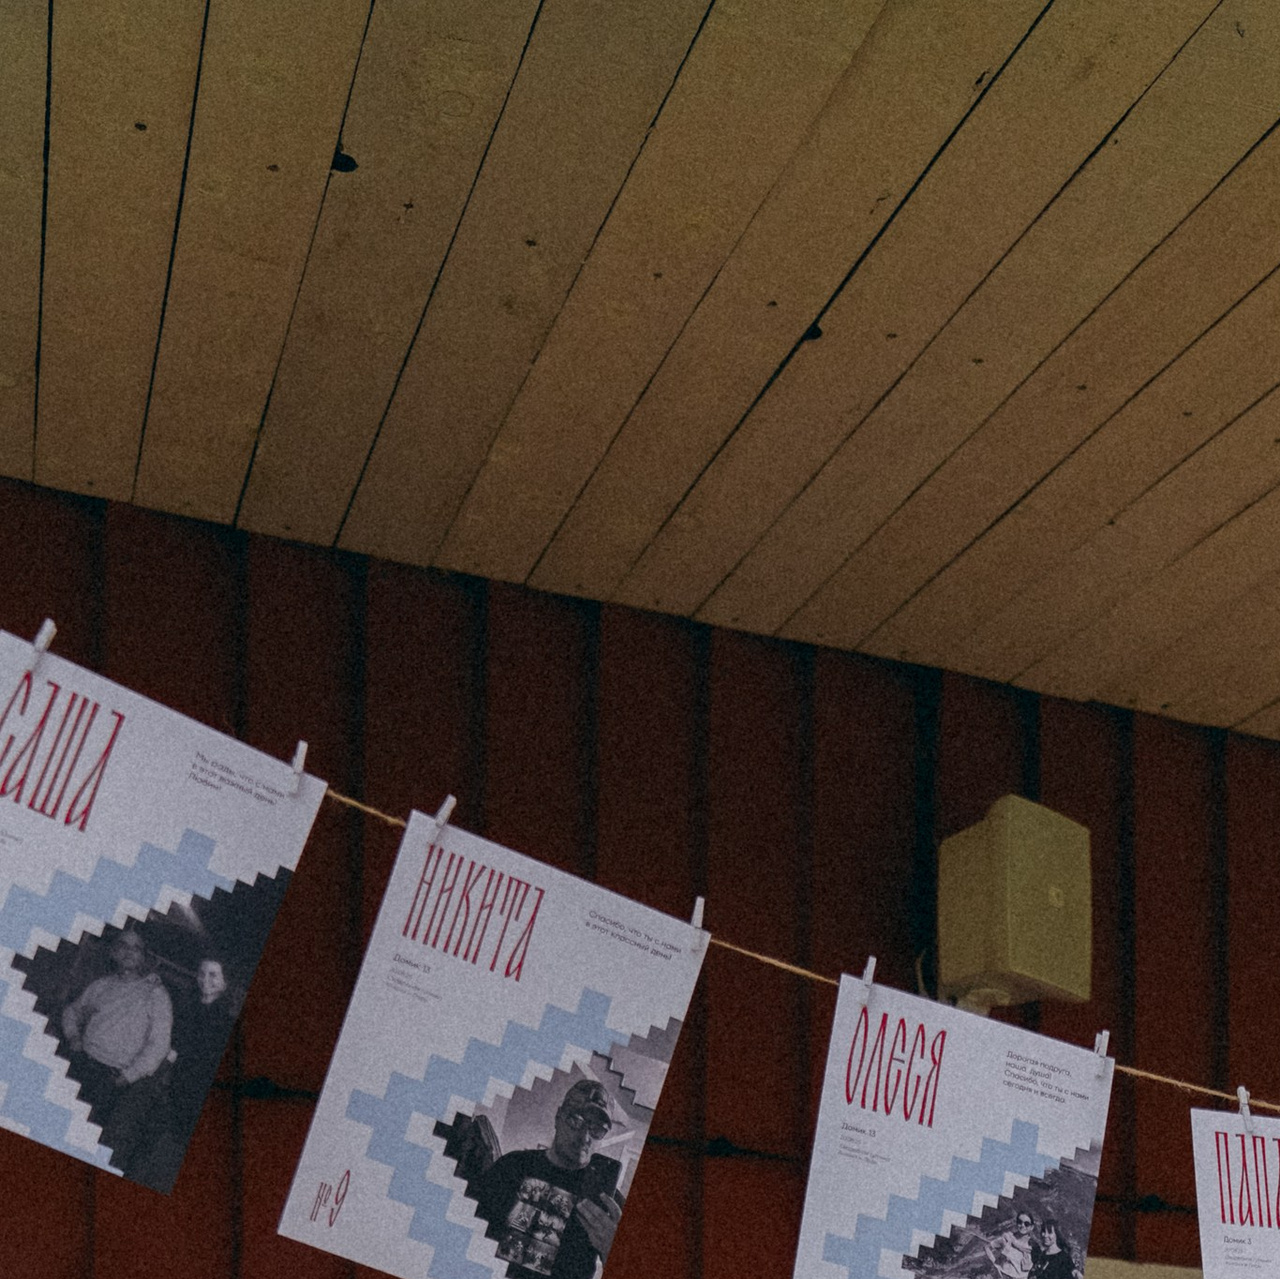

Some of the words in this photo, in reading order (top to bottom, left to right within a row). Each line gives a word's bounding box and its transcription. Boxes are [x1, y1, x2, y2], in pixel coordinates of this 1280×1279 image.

[402, 843, 545, 982] НИКИТА
[587, 910, 627, 932] Спасибо,
[627, 929, 642, 937] что
[660, 942, 682, 954] нами
[591, 924, 608, 934] этот
[610, 931, 649, 951] классный
[650, 947, 672, 961] день!
[392, 953, 420, 970] Домик
[845, 1005, 947, 1128] ОЛЕСЯ
[1005, 1061, 1026, 1072] наша
[1029, 1067, 1051, 1081] душа!
[1006, 1050, 1038, 1067] Дорогая
[1039, 1061, 1072, 1078] подруга,
[1002, 1079, 1032, 1094] сегодня
[1004, 1068, 1039, 1086] Спасибо,
[1040, 1081, 1052, 1089] что
[1070, 1090, 1089, 1100] нами
[841, 1121, 865, 1135] Домик
[868, 1128, 876, 1137] 13
[1223, 1234, 1245, 1245] Домик
